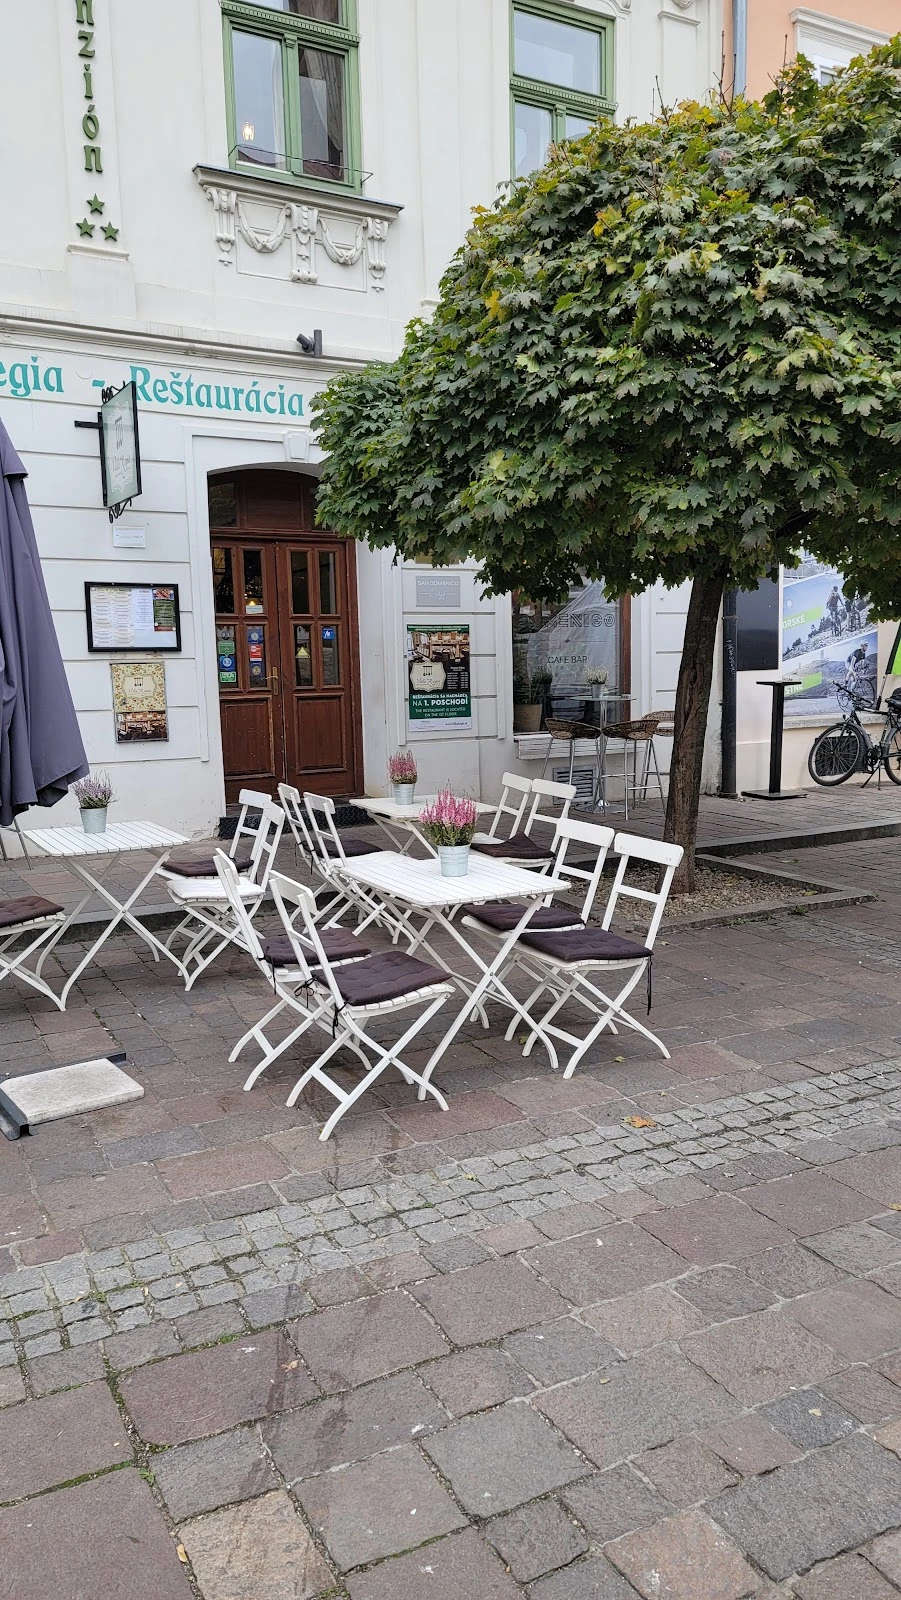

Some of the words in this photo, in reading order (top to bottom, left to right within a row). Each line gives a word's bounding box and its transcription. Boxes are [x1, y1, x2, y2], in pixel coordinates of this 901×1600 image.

[129, 365, 305, 416] Reštaurácia
[547, 656, 570, 664] CAFE
[571, 656, 588, 664] BAR
[431, 697, 468, 706] POSCHODÍ
